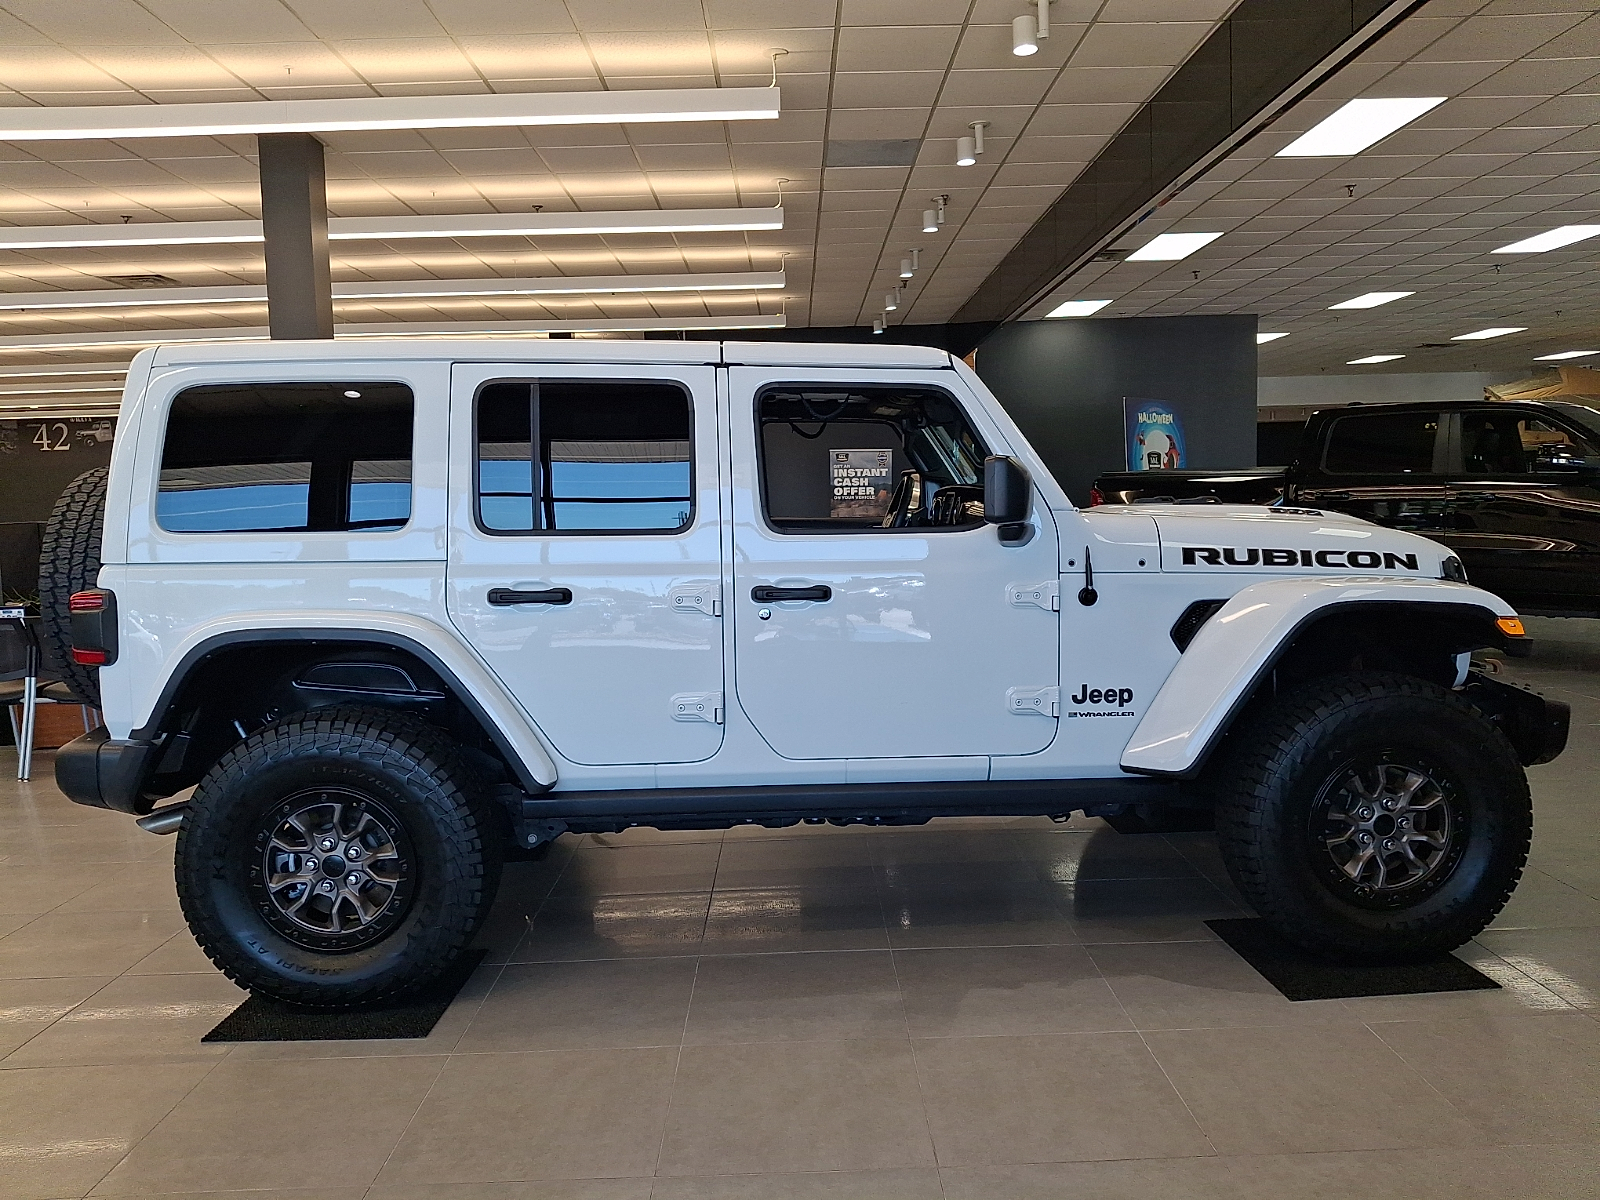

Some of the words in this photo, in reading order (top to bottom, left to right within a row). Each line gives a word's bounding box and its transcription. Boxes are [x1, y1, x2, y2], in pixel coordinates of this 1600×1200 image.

[1138, 412, 1173, 424] HALLOWEEN
[32, 422, 71, 451] 42
[834, 469, 888, 477] INSTANT
[833, 478, 869, 486] CASH
[833, 487, 875, 496] OFFER
[1181, 546, 1420, 571] RUBICON
[1071, 683, 1134, 707] Jeep
